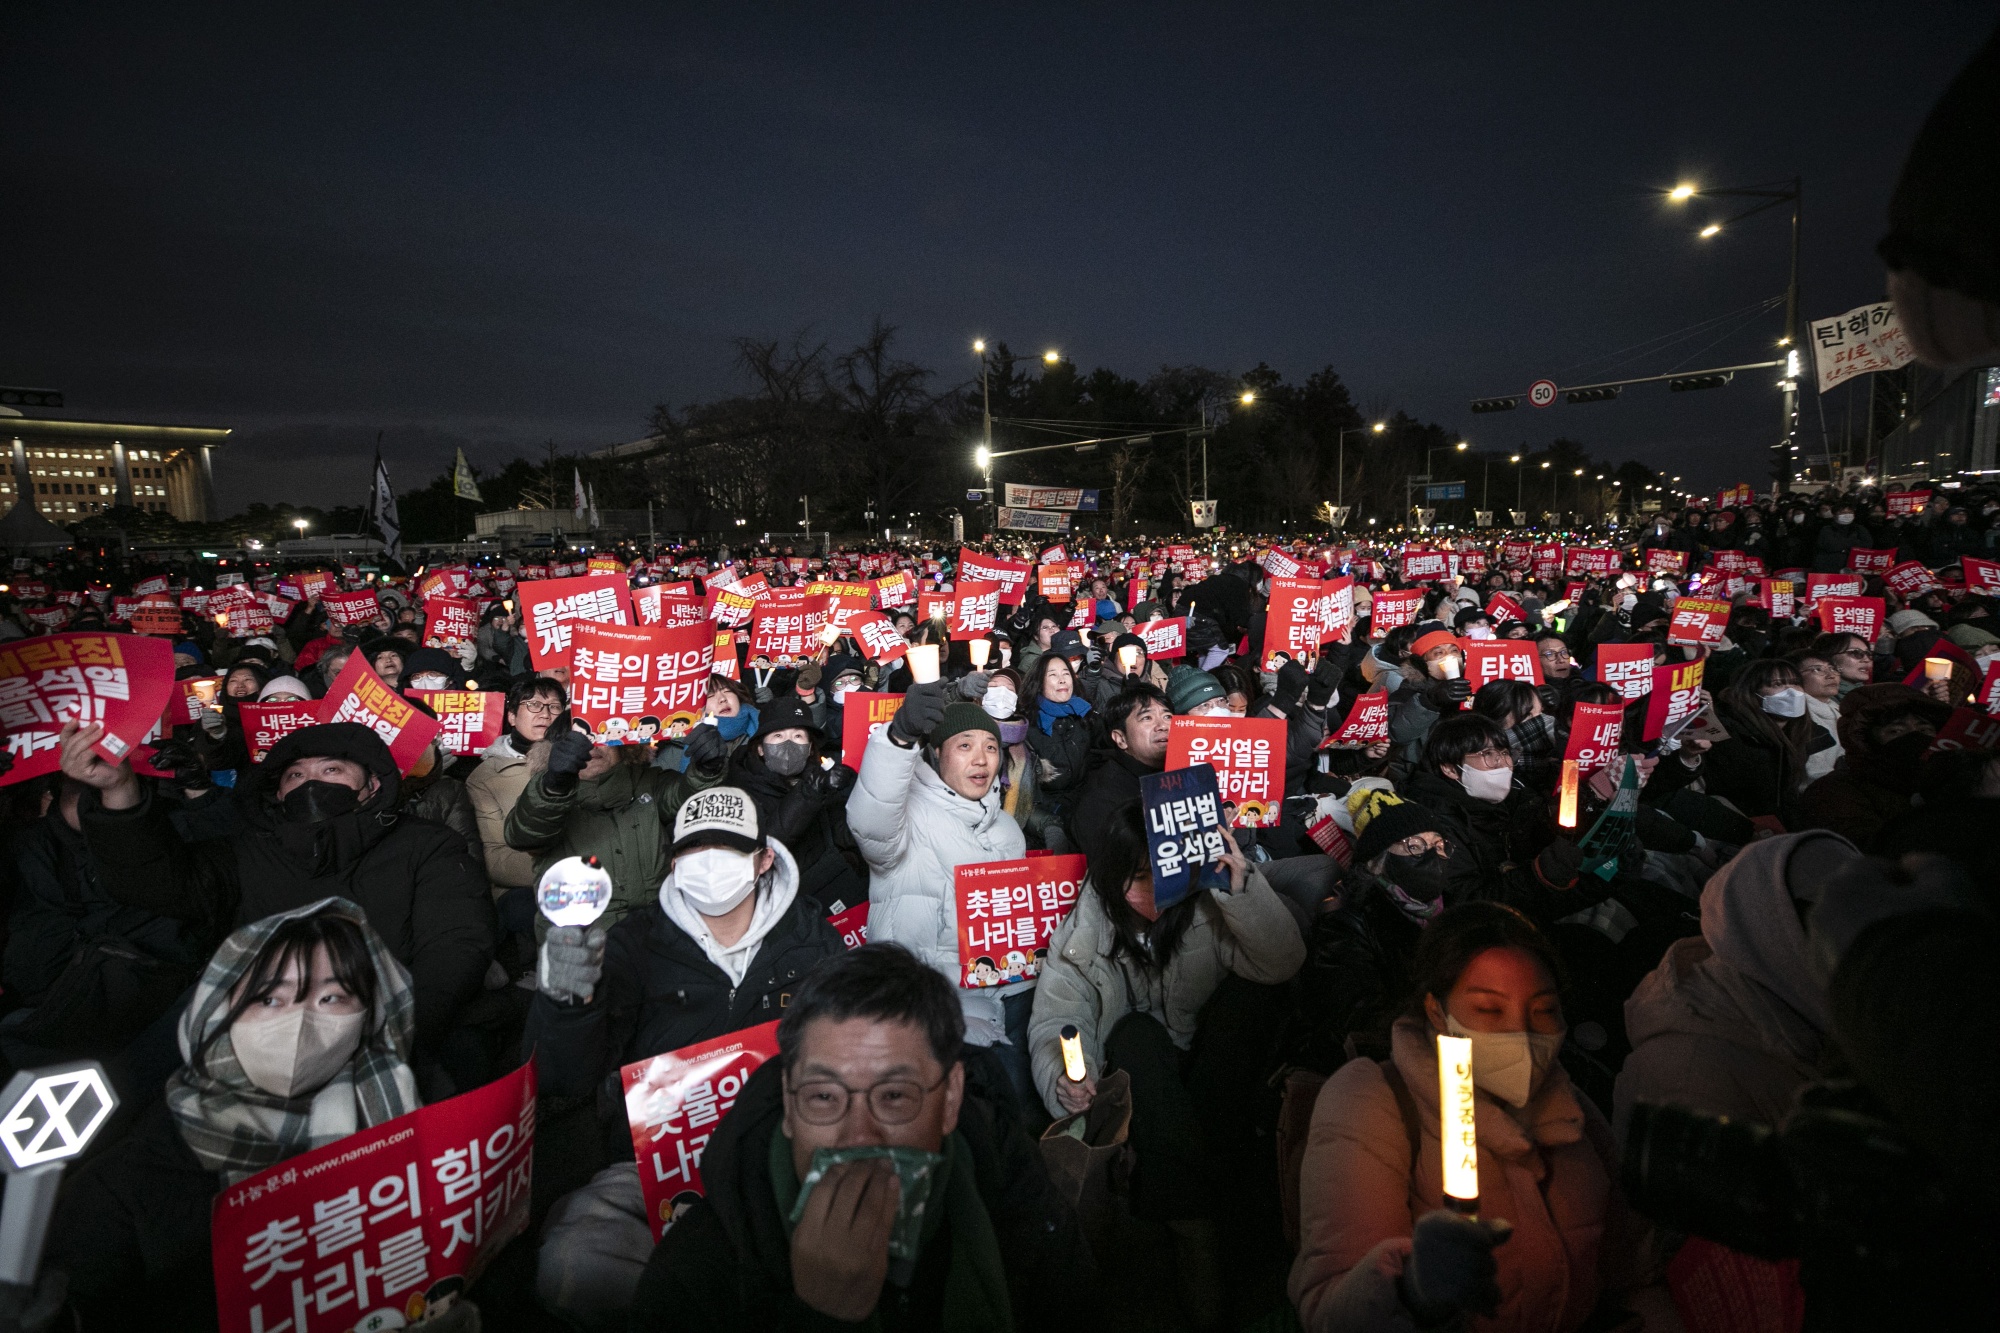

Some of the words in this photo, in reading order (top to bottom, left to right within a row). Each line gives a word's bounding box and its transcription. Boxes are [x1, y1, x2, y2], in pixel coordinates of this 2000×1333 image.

[1535, 388, 1551, 400] 50
[589, 560, 615, 569] 내란수괴
[1266, 551, 1301, 574] 김건희를
[1407, 555, 1443, 567] 윤석열을
[1466, 556, 1484, 567] 탄핵
[1571, 560, 1592, 568] 윤석열
[1593, 561, 1607, 569] 체포
[1576, 552, 1605, 561] 내란수괴
[1648, 559, 1668, 567] 윤석열
[1653, 552, 1677, 561] 내란수괴
[1855, 554, 1889, 568] 탄핵
[962, 561, 1026, 583] 김건희특검
[1407, 564, 1446, 577] 거부한다!
[876, 572, 905, 589] 내란죄
[1276, 581, 1296, 589] 나눔문화
[806, 584, 843, 596] 내란수괴
[844, 585, 870, 597] 윤석열
[879, 583, 907, 601] 윤석열
[345, 597, 376, 609] 힘으로
[532, 587, 618, 630] 윤석열을
[716, 590, 756, 610] 내란죄
[881, 595, 903, 609] 탄핵!
[1376, 600, 1405, 613] 촛불의
[1676, 600, 1712, 612] 내란수괴
[349, 607, 378, 621] 지키자
[711, 602, 751, 618] 윤석열
[1376, 613, 1405, 625] 나라를
[1833, 607, 1875, 625] 윤석열을
[433, 619, 469, 637] 윤석열
[759, 614, 802, 634] 촛불의
[805, 610, 828, 631] 힘으로
[1672, 611, 1710, 629] 즉각
[575, 623, 596, 634] 나눔문화
[597, 630, 651, 641] www.nanum.com
[755, 635, 802, 653] 나라를
[573, 647, 649, 682] 촛불의
[655, 644, 713, 681] 힘으로
[1481, 654, 1535, 685] 탄핵
[0, 666, 129, 705] 윤석열
[353, 671, 414, 728] 내란죄
[424, 692, 486, 713] 내란죄
[571, 683, 647, 715] 나라를
[0, 694, 106, 729] 퇴진!
[339, 692, 402, 746] 윤석열
[1580, 707, 1602, 715] 나눔문화
[1175, 720, 1195, 728] 나눔문화
[1342, 723, 1377, 739] 윤석열
[1188, 738, 1271, 767] 윤석열을
[1149, 792, 1219, 836] 내란범
[1157, 829, 1226, 877] 윤석열
[960, 867, 986, 877] 나눔문화
[987, 865, 1029, 875] www.nanum.com
[966, 883, 1033, 920] 촛불의
[968, 918, 1037, 951] 나라를
[644, 1068, 749, 1143] 촛불의
[229, 1167, 299, 1208] 나눔문화
[302, 1128, 414, 1179] www.nanum.com
[243, 1162, 421, 1292] 촛불의
[431, 1100, 536, 1206] 힘으로
[250, 1226, 430, 1333] 나라를
[440, 1145, 533, 1259] 지키자
